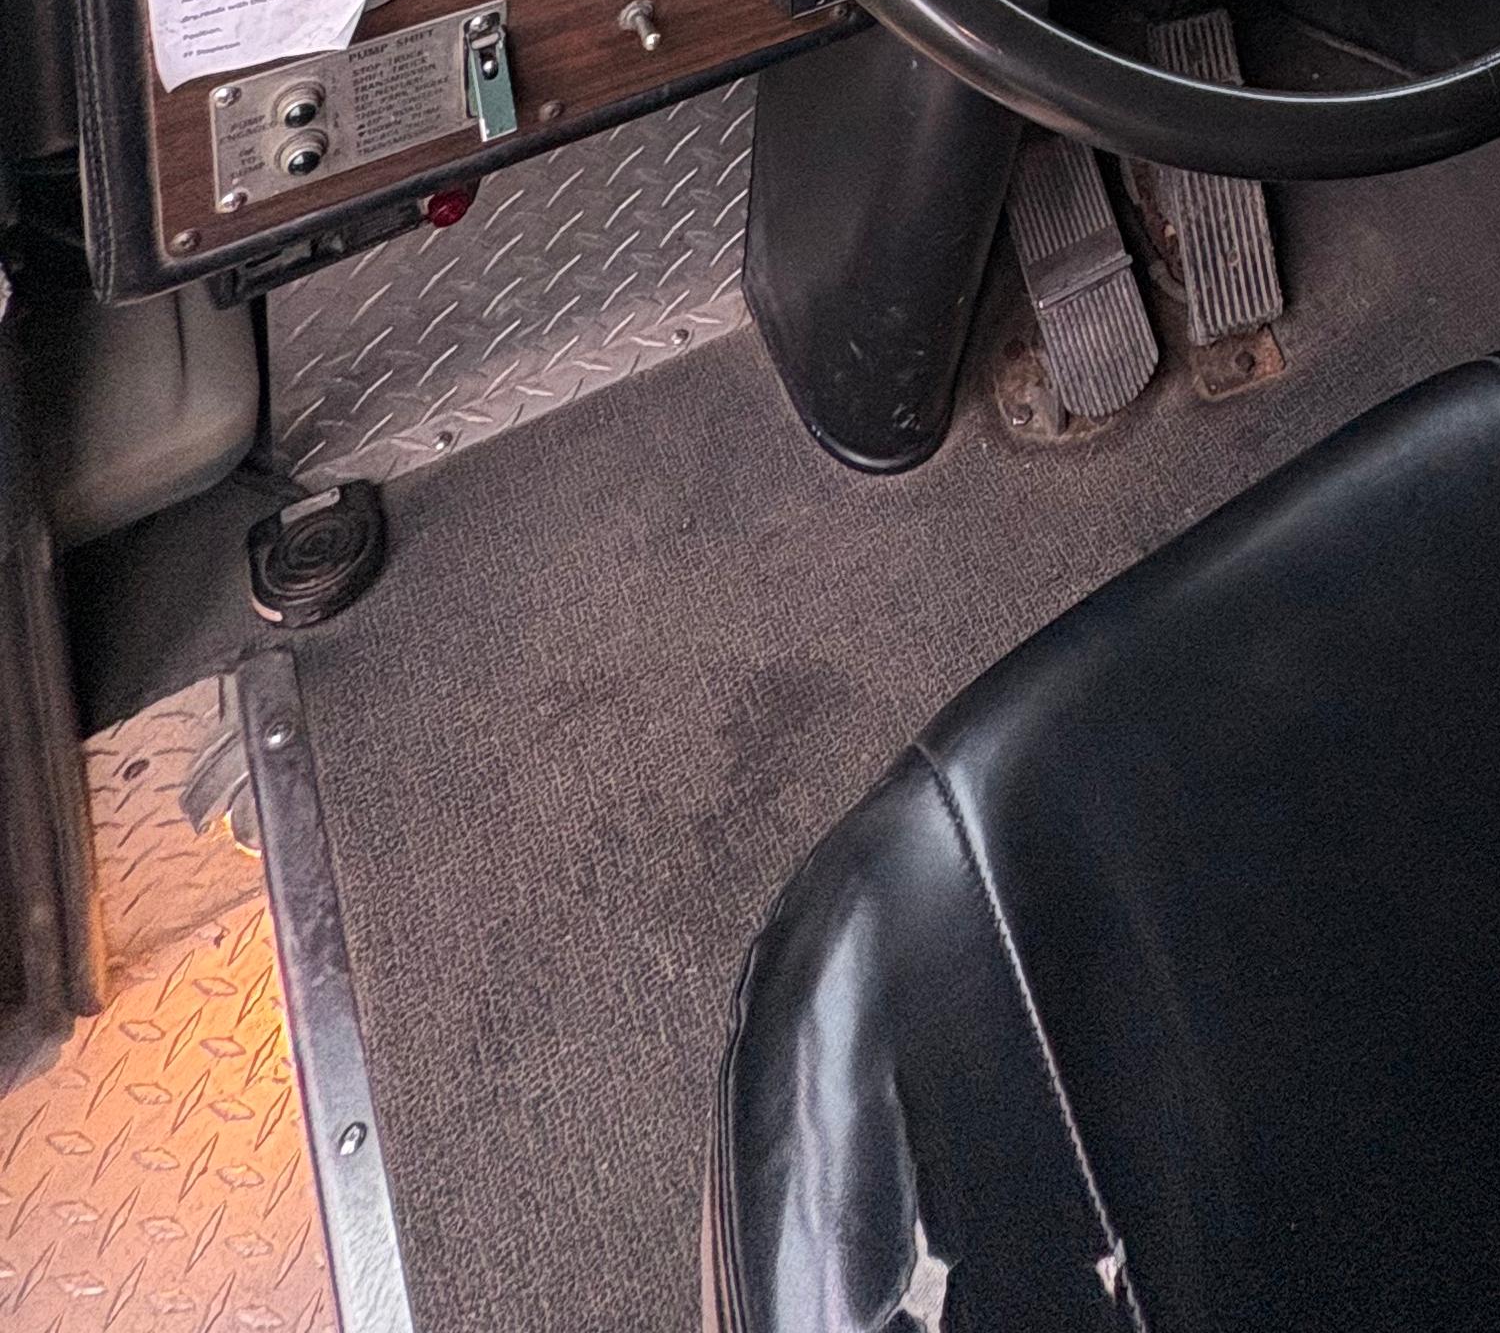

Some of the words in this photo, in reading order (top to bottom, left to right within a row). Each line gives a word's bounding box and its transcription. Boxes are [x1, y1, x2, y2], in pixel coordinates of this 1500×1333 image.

[349, 44, 388, 63] PUMP
[396, 29, 434, 45] SHIFT
[353, 63, 381, 76] STOP
[353, 71, 384, 86] SHIFT
